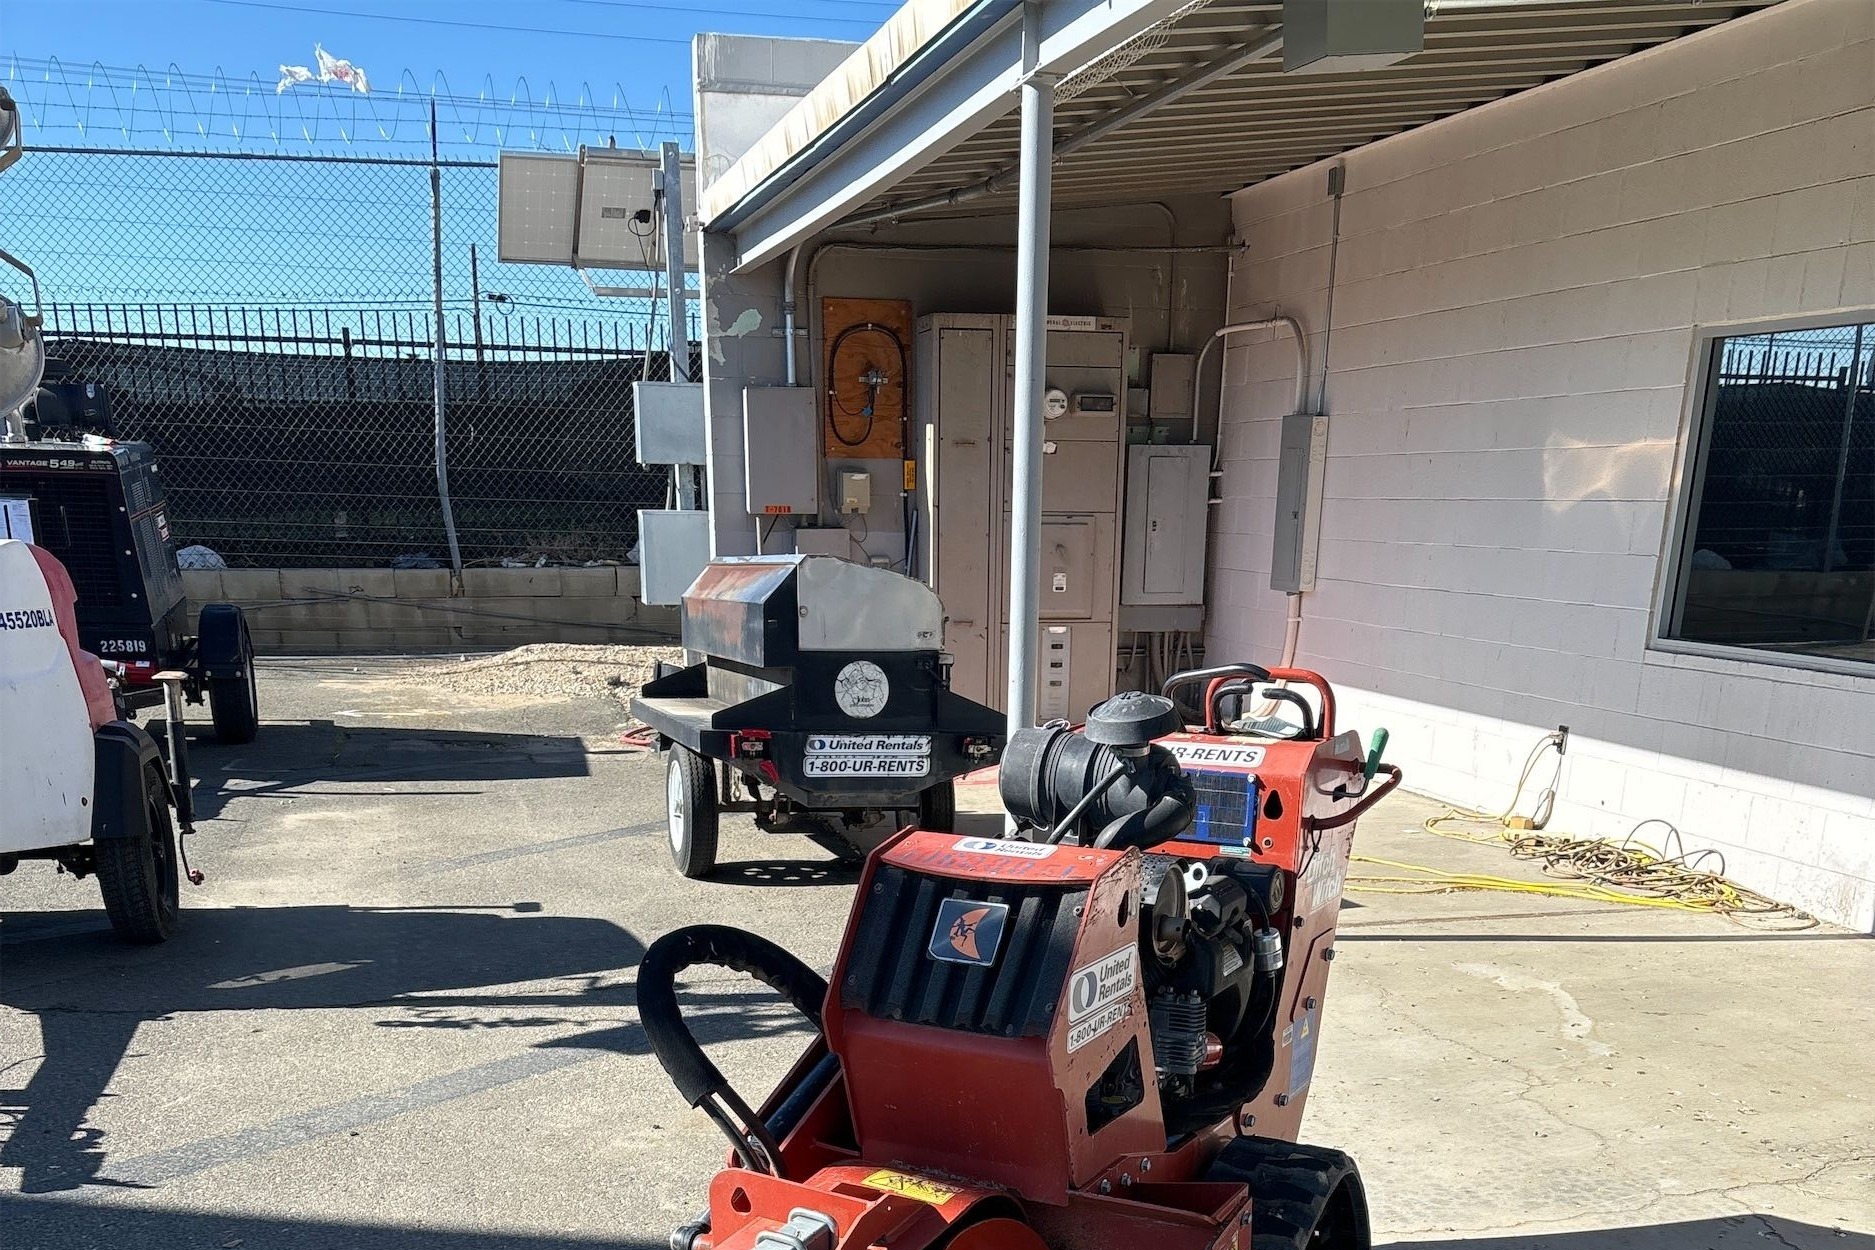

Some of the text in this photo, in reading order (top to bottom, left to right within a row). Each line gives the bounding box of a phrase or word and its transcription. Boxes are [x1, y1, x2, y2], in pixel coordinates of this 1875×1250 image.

[49, 459, 76, 468] 549
[0, 608, 54, 630] 45520BLA
[100, 640, 146, 653] 225819
[829, 740, 923, 750] United Rentals
[807, 760, 925, 772] 1-800-UR-RENTS
[1001, 843, 1046, 851] United
[1100, 951, 1133, 983] United
[1098, 971, 1133, 1001] Rentals
